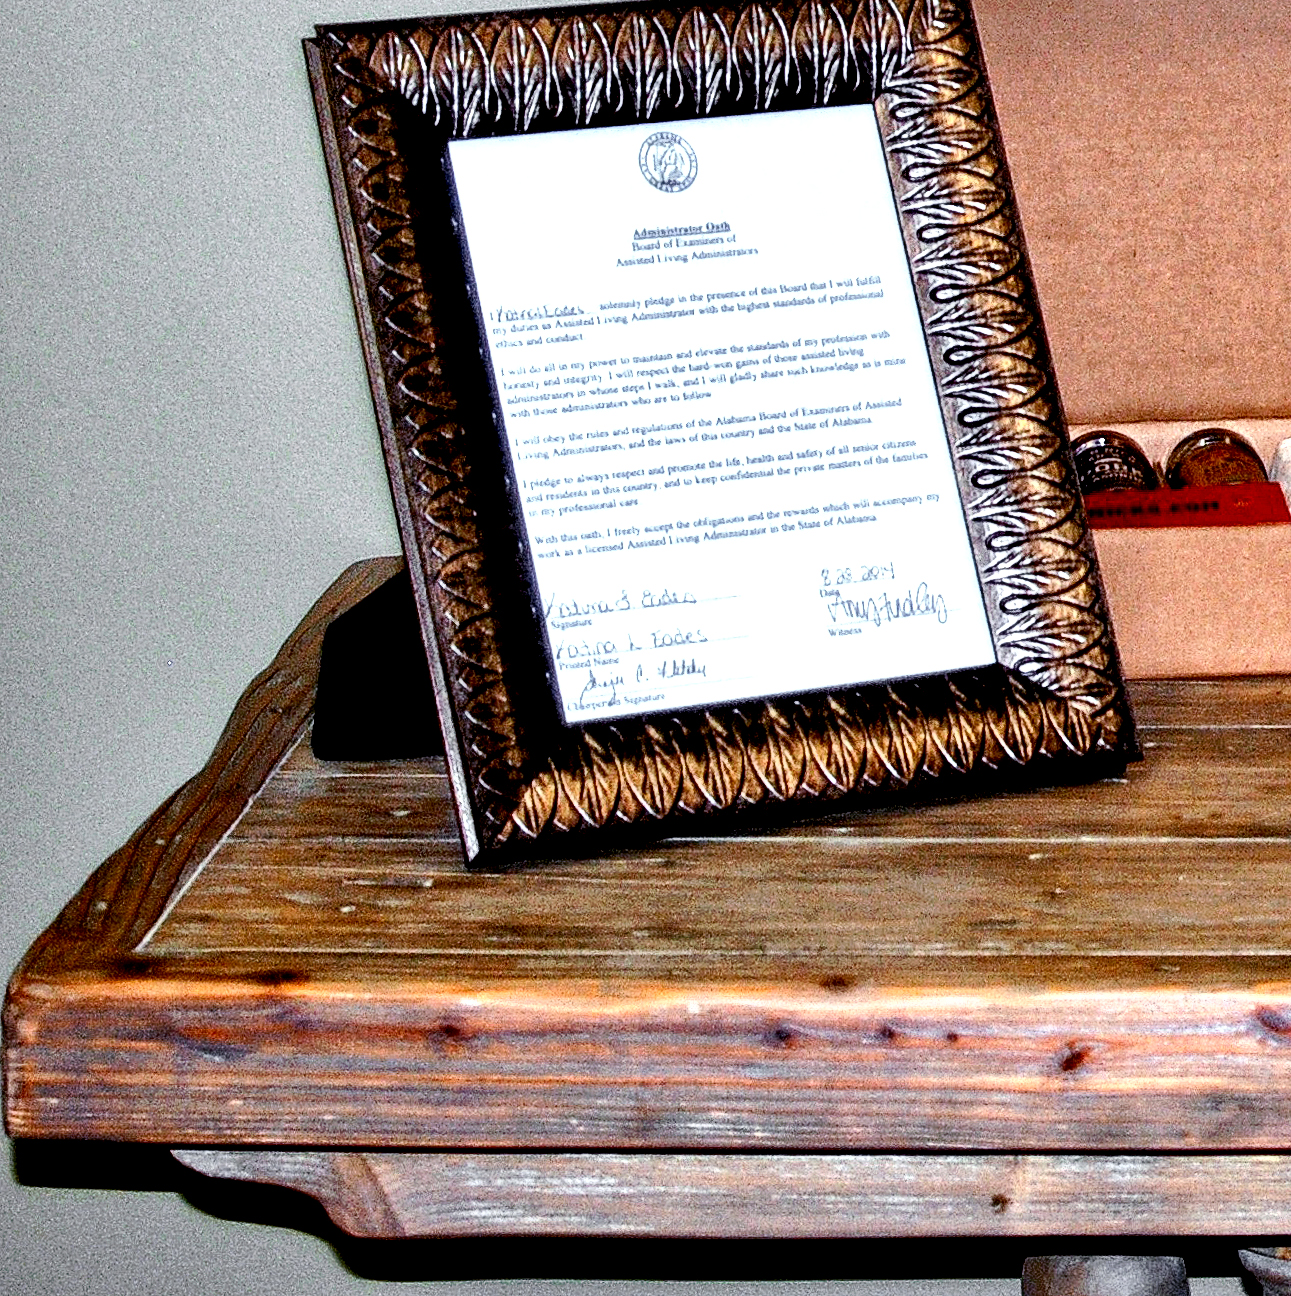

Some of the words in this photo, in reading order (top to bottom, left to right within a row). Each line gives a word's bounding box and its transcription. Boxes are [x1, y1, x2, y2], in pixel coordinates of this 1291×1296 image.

[633, 225, 704, 239] Administrator
[705, 221, 731, 233] Oath
[631, 240, 660, 251] Board
[663, 238, 672, 248] of
[726, 234, 736, 242] of
[616, 255, 654, 266] Assisted
[656, 254, 688, 263] Living
[691, 248, 758, 259] Administrators
